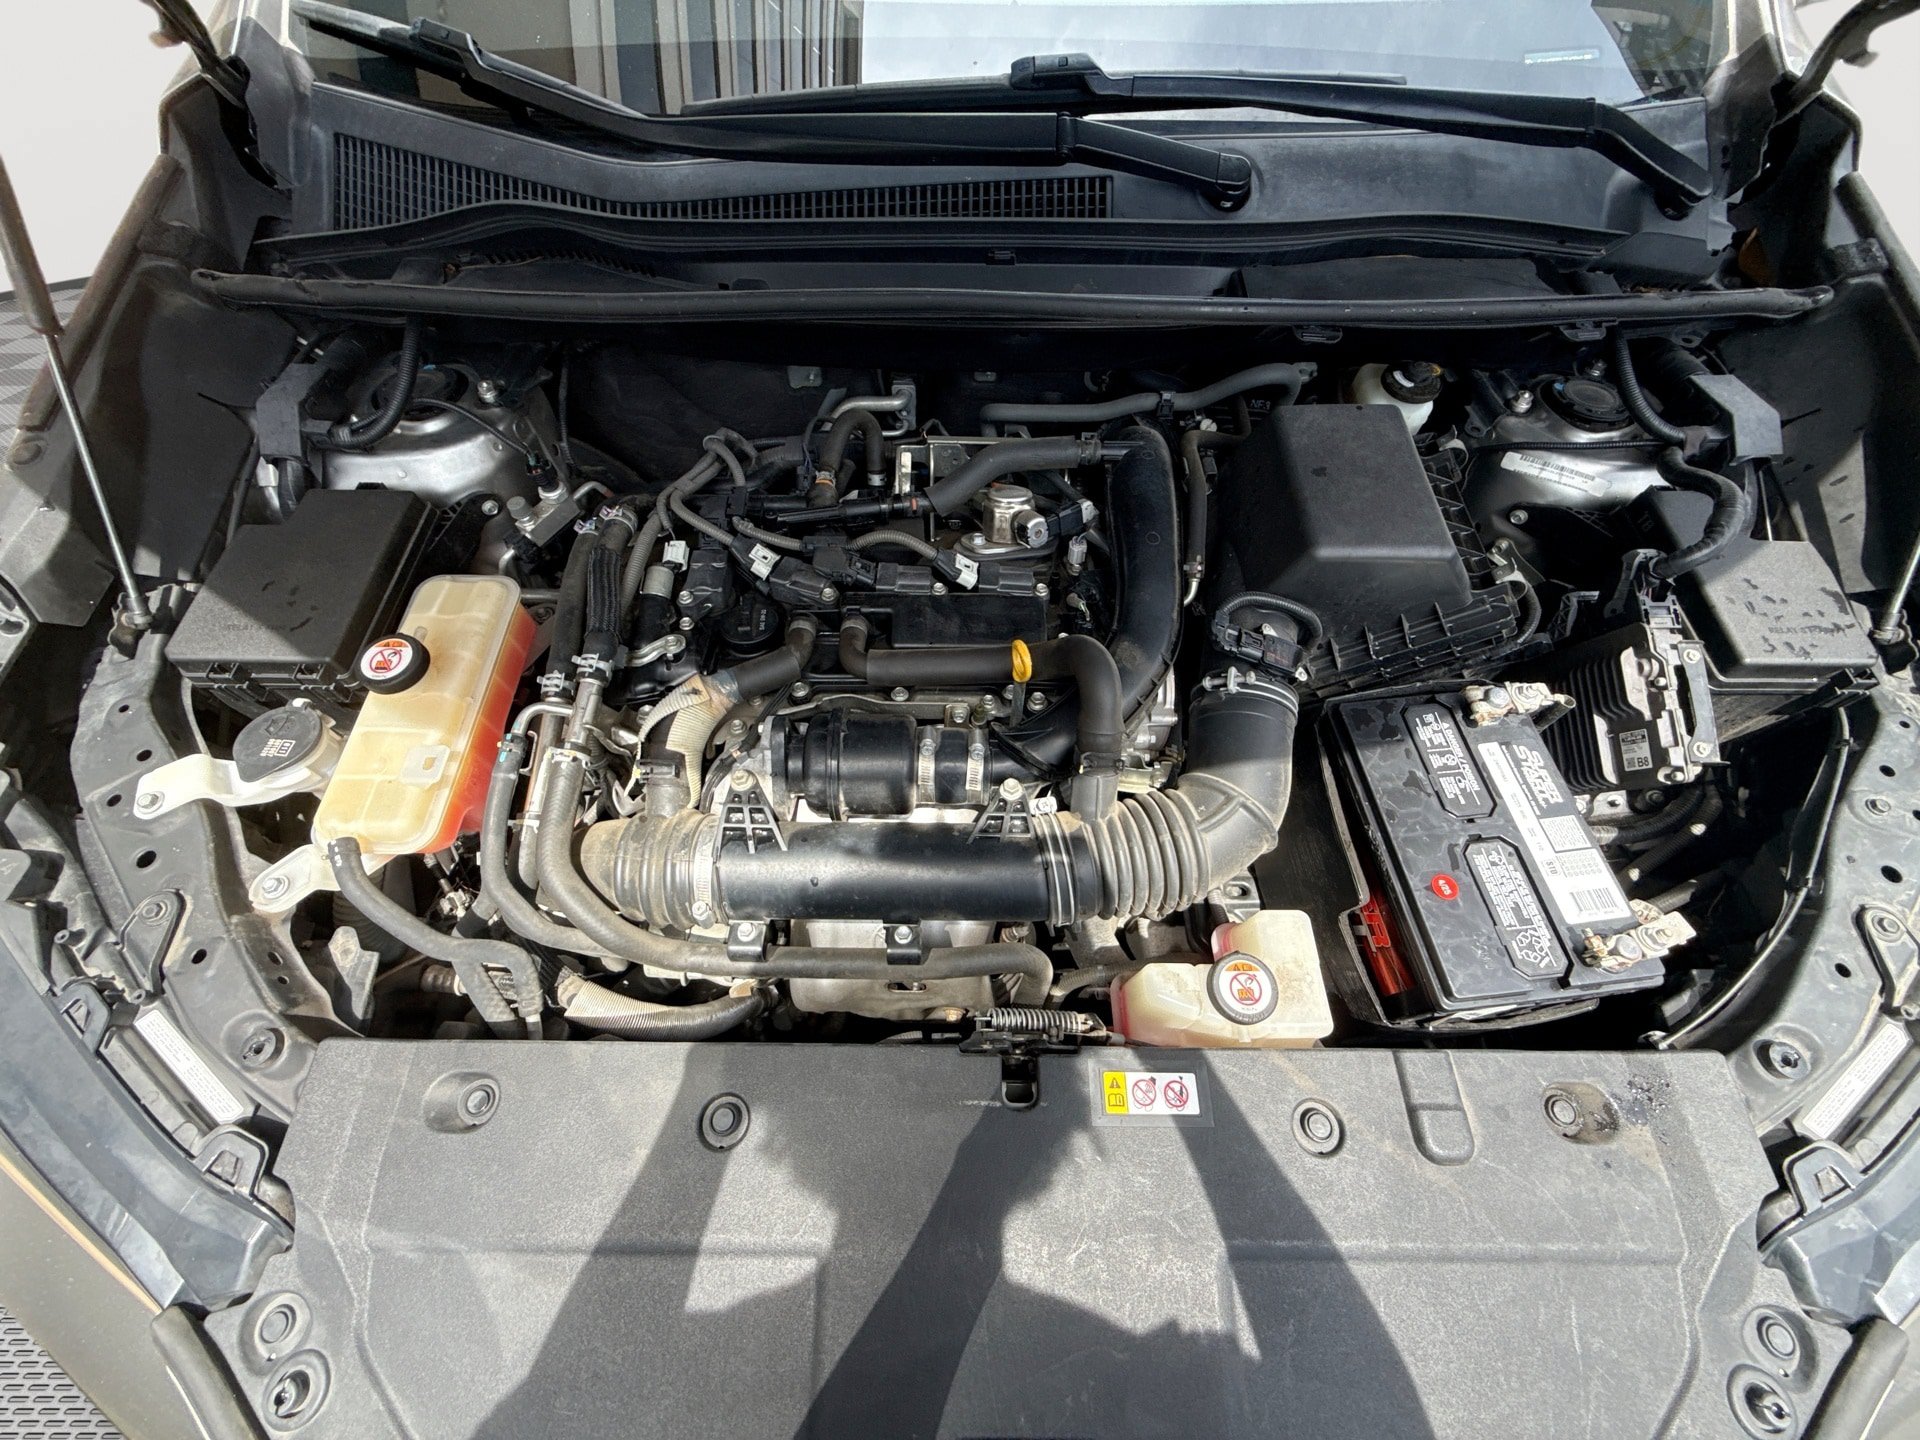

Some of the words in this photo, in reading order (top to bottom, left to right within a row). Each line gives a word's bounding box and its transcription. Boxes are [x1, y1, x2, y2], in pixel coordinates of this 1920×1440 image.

[1446, 729, 1464, 757] DANGER
[1513, 744, 1554, 805] START
[1637, 756, 1649, 768] B8
[1530, 750, 1563, 803] SUPER
[1546, 861, 1558, 875] STD
